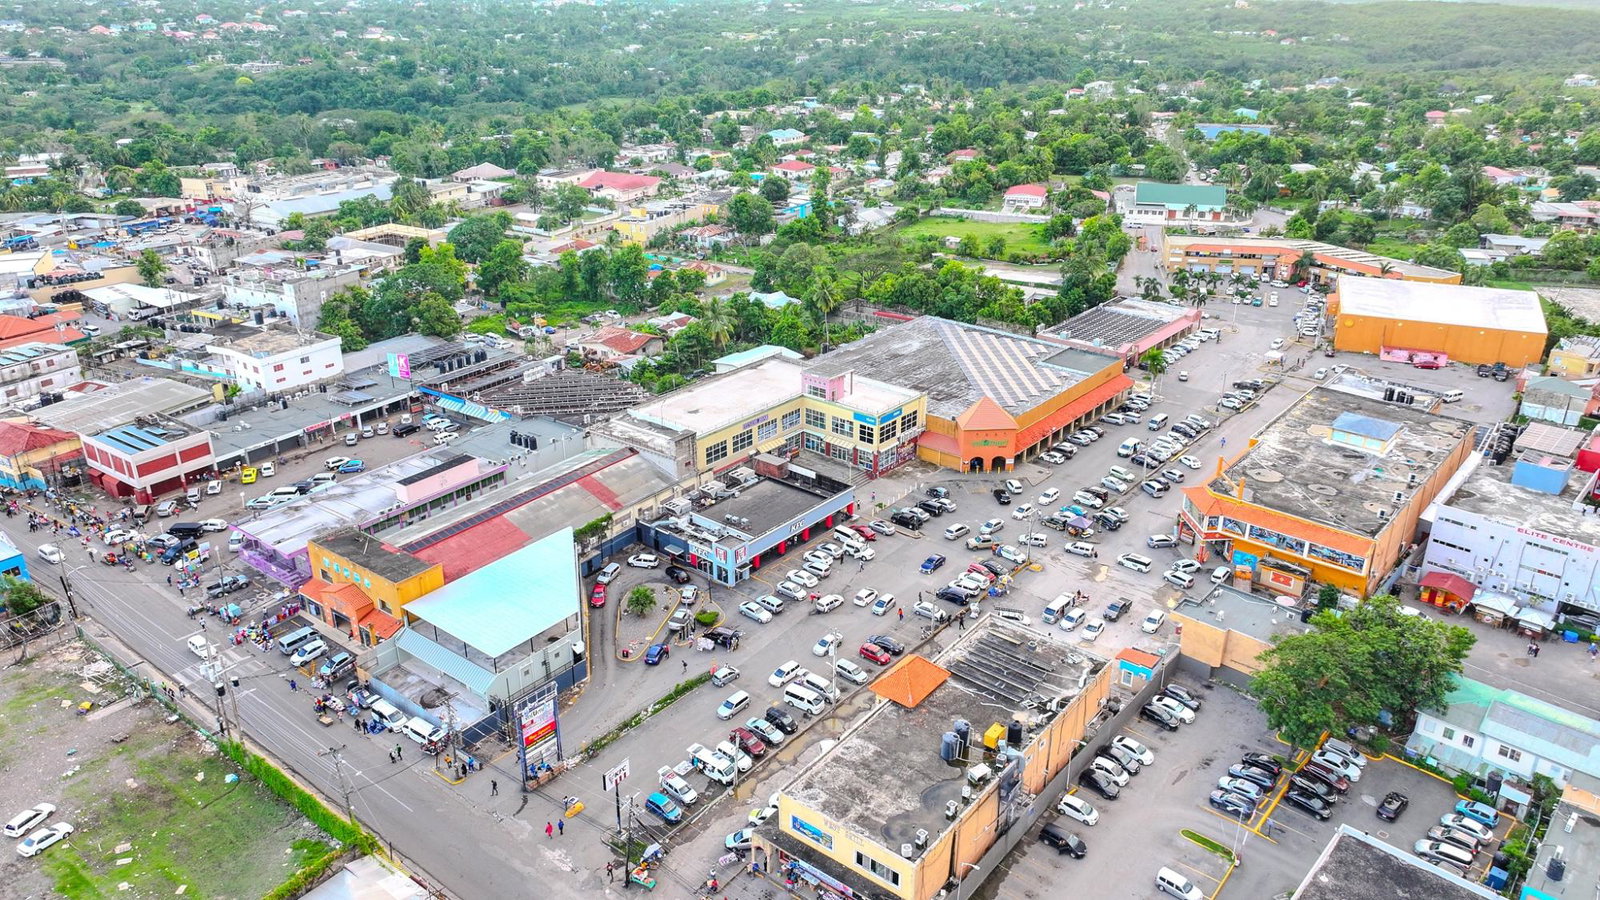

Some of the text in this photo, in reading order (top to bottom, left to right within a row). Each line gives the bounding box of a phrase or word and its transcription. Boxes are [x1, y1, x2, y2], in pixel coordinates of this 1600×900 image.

[789, 519, 804, 532] KFC
[1517, 527, 1595, 553] ELITE CENTRE
[692, 546, 710, 558] KFC
[614, 764, 627, 778] KFC
